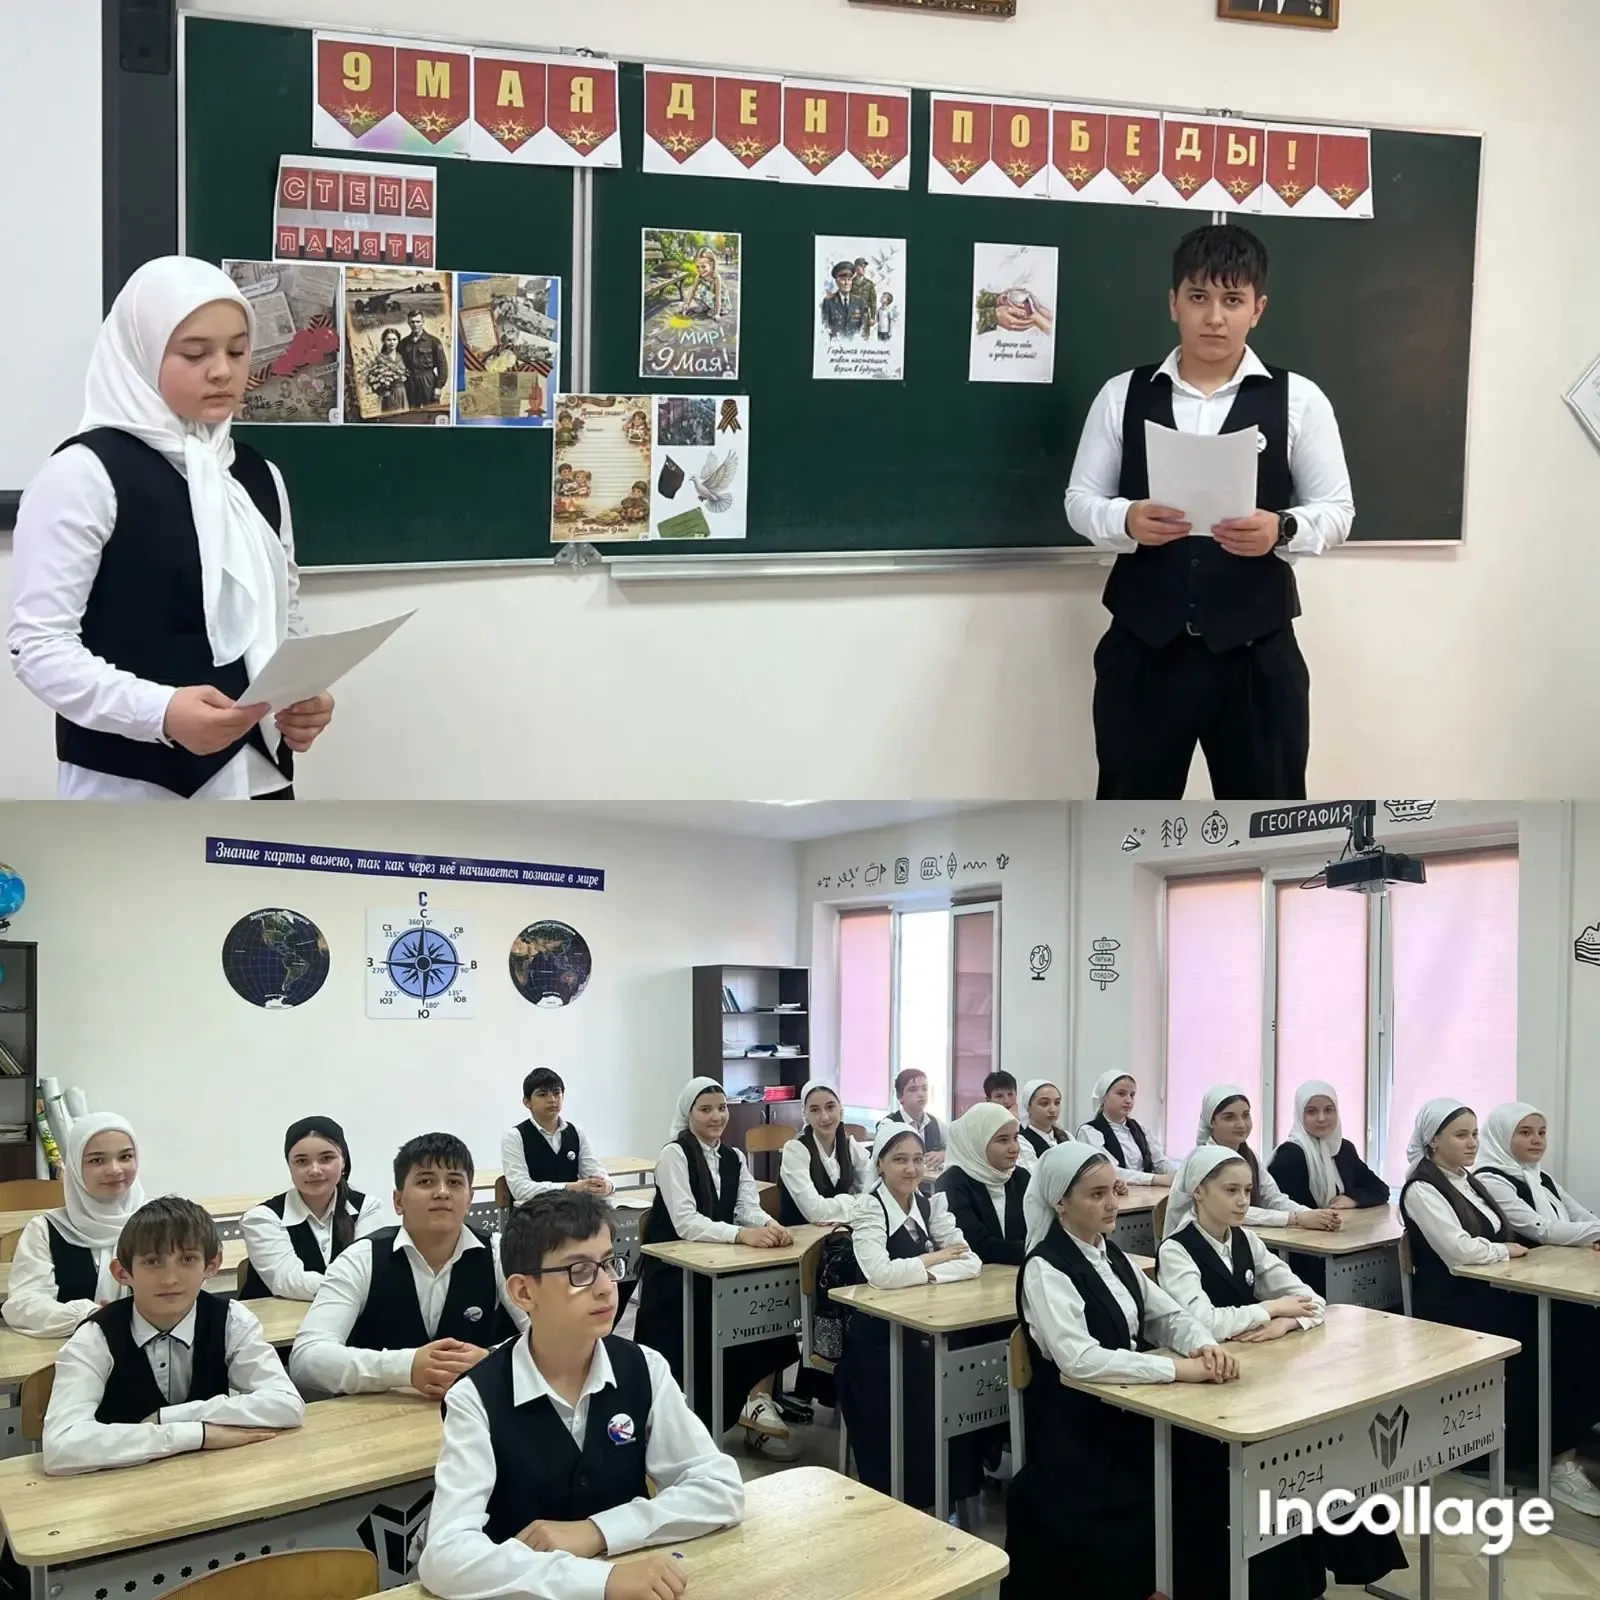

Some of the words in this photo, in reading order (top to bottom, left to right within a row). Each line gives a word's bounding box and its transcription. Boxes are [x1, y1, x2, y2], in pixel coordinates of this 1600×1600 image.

[342, 50, 372, 92] 9
[415, 59, 595, 114] МАЯ
[666, 82, 890, 138] ДЕНЬ
[951, 109, 1298, 171] ПОБЕДЫ!
[283, 176, 430, 211] СТЕНА
[279, 232, 430, 260] ПАМЯТИ
[651, 346, 675, 371] 9
[673, 347, 731, 374] Мая!
[1260, 804, 1353, 833] ГЕОГРАФИЯ
[215, 841, 260, 861] Знание
[263, 849, 306, 866] карты
[310, 853, 353, 870] важно,
[357, 857, 381, 870] так
[384, 858, 405, 872] как
[408, 861, 436, 877] через
[439, 861, 456, 876] неё
[459, 865, 519, 880] начинается
[522, 870, 565, 883] познание
[567, 874, 574, 883] в
[576, 875, 600, 888] мире
[418, 891, 428, 907] С
[420, 909, 428, 918] С
[382, 924, 392, 932] СЗ
[453, 926, 464, 934] СВ
[470, 960, 478, 970] В
[379, 997, 393, 1005] ЮЗ
[453, 996, 467, 1004] ЮВ
[418, 1009, 430, 1019] Ю
[749, 1296, 792, 1316] 2+2=4
[1278, 1463, 1325, 1499] 2+2=4
